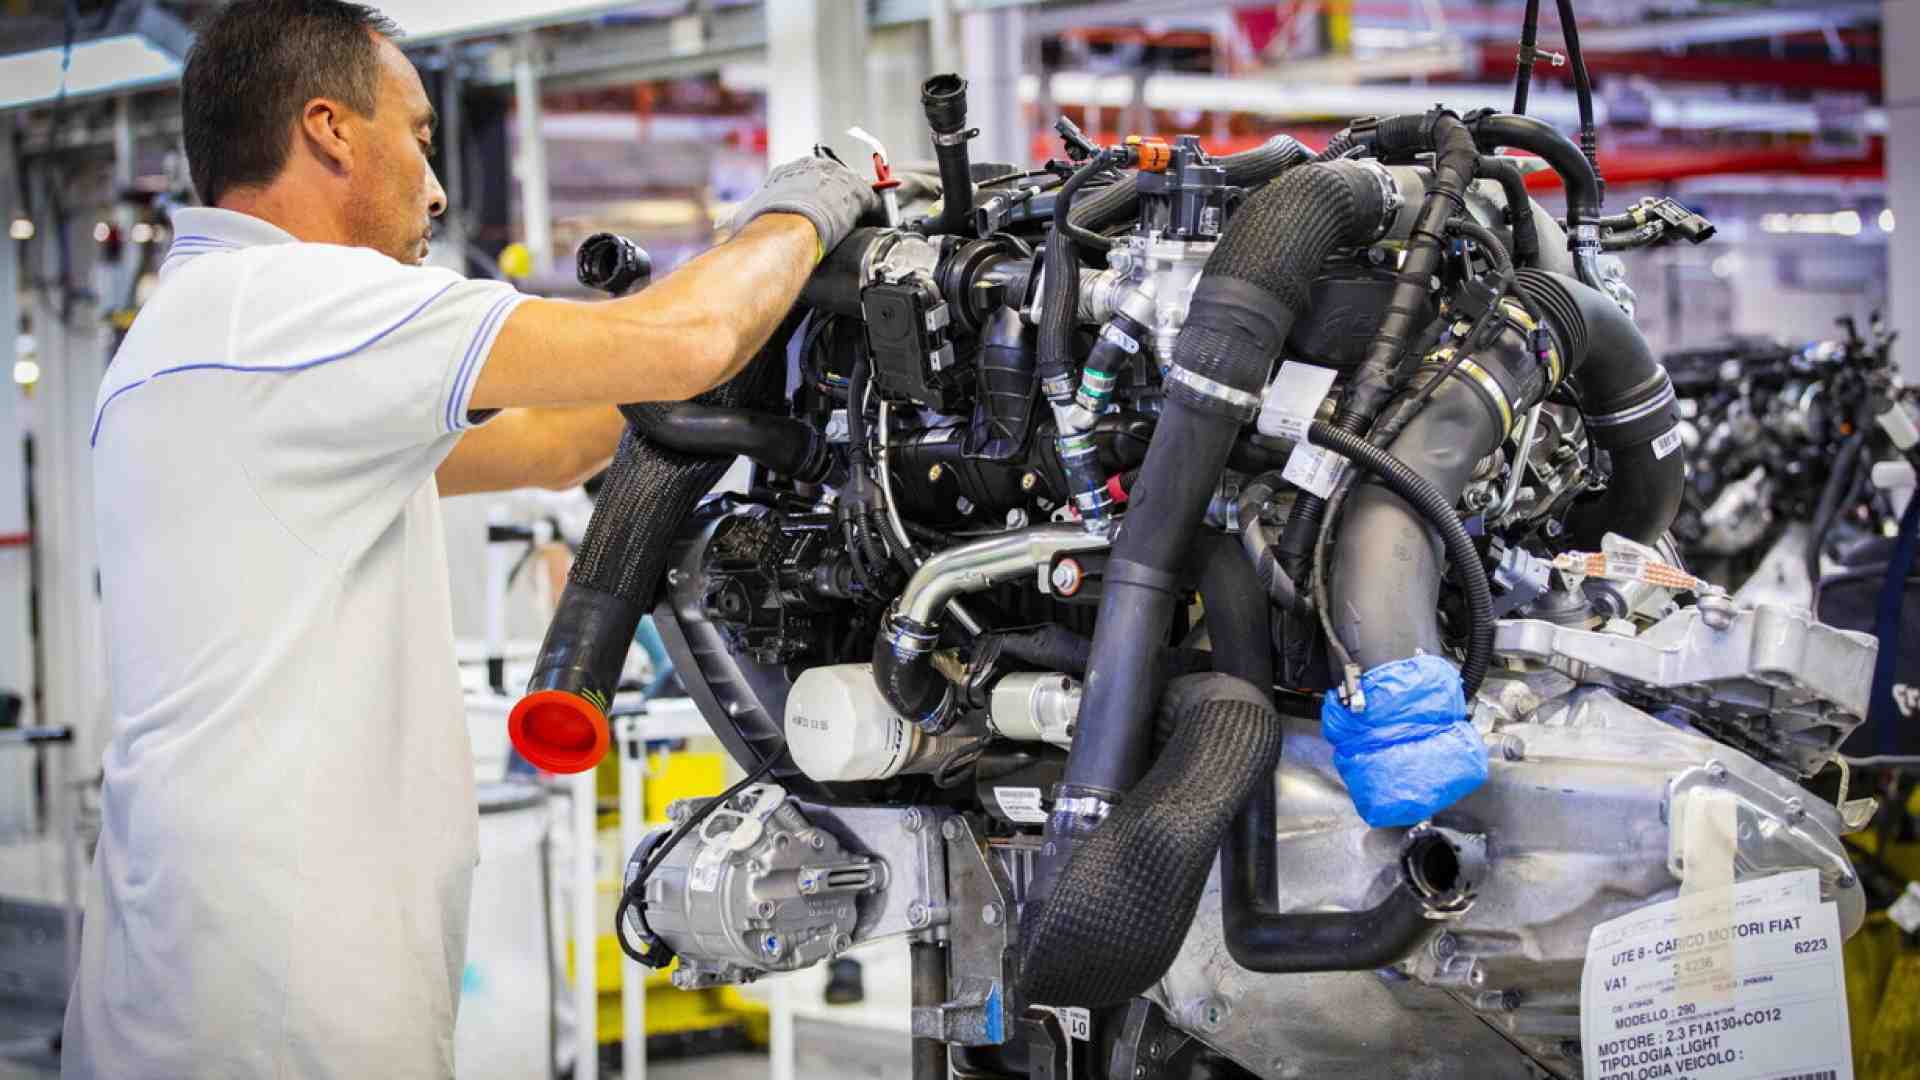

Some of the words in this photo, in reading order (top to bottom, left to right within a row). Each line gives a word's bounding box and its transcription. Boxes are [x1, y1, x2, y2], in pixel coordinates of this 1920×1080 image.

[1612, 950, 1635, 967] UTE
[1769, 917, 1802, 934] FIAT
[1794, 938, 1828, 953] 6223
[1604, 976, 1627, 992] VA1
[1615, 1008, 1668, 1029] MODELLO
[1599, 1033, 1655, 1057] MOTORE
[1666, 1027, 1686, 1042] 2.3
[1600, 1046, 1673, 1073] TIPOLOGIA
[1600, 1063, 1672, 1080] POLOGIA
[1675, 1050, 1736, 1073] VEICOLO
